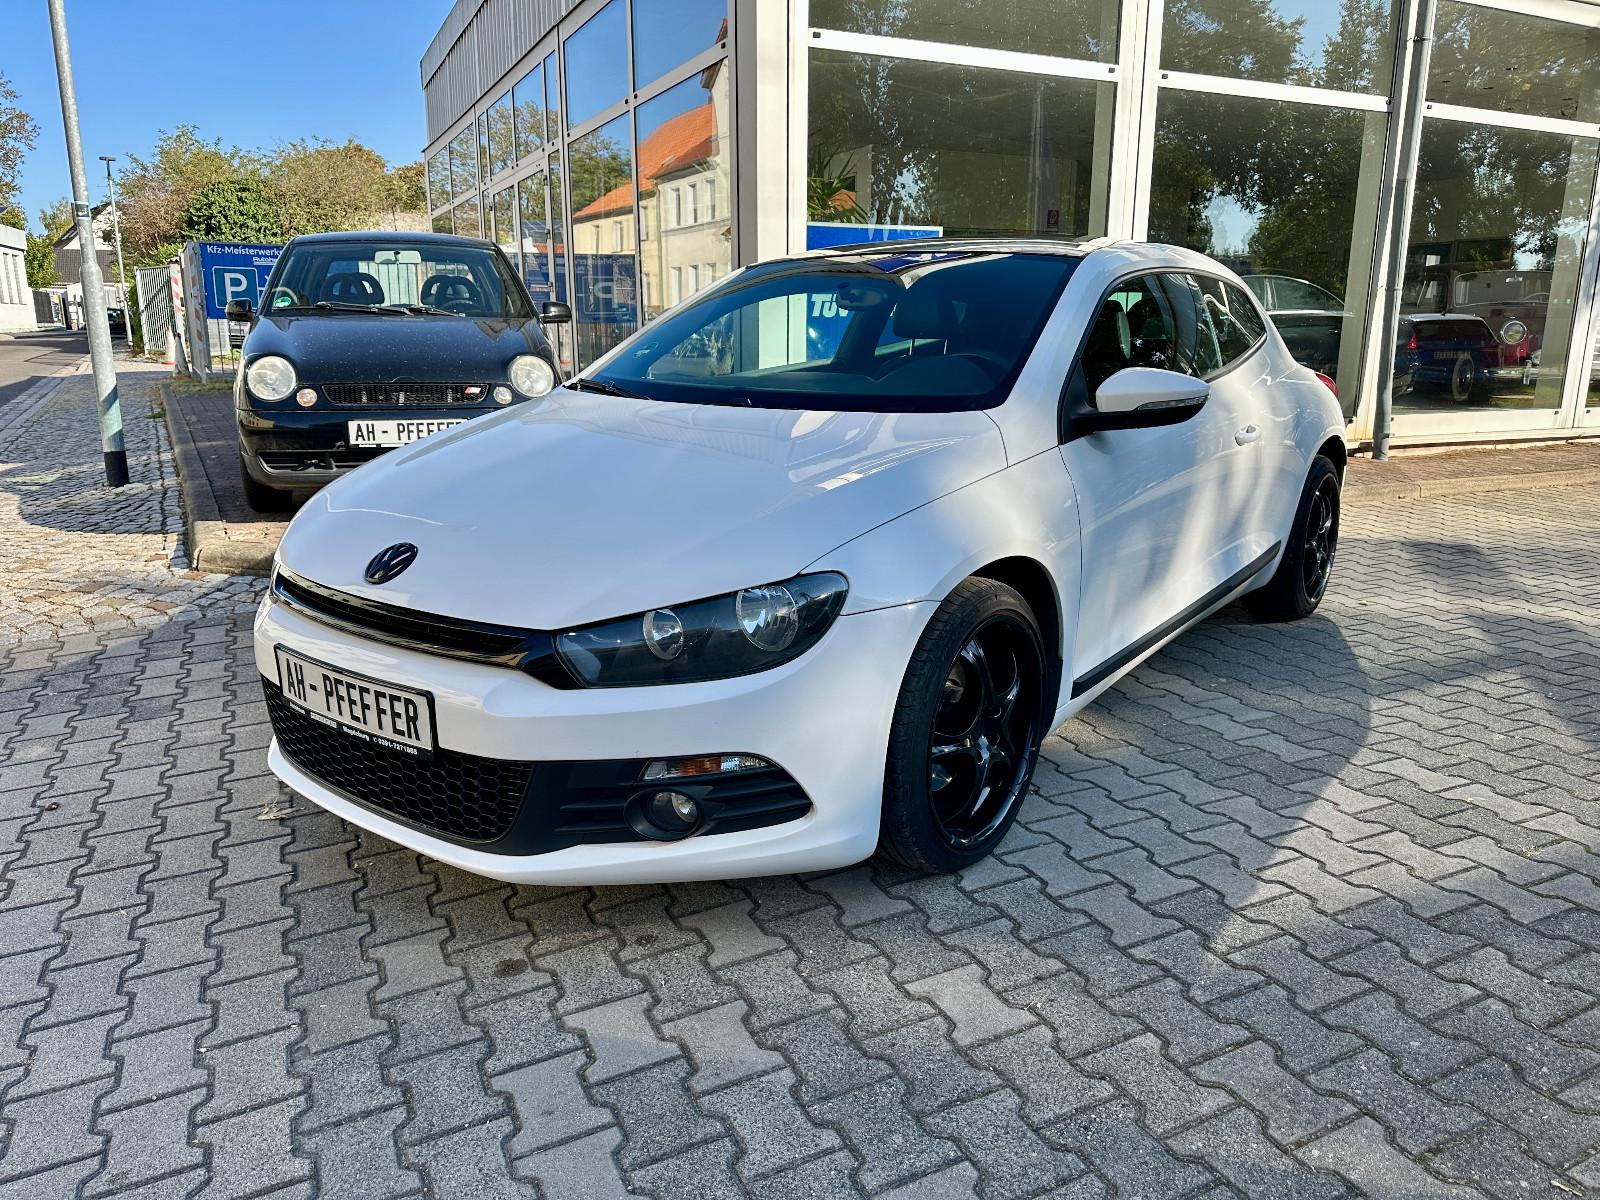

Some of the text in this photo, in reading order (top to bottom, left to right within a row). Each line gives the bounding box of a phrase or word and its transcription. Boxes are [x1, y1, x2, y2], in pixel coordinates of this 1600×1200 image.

[207, 245, 282, 256] Kfz-Meisterwerk
[224, 272, 248, 303] P
[322, 672, 421, 741] PFEFFER
